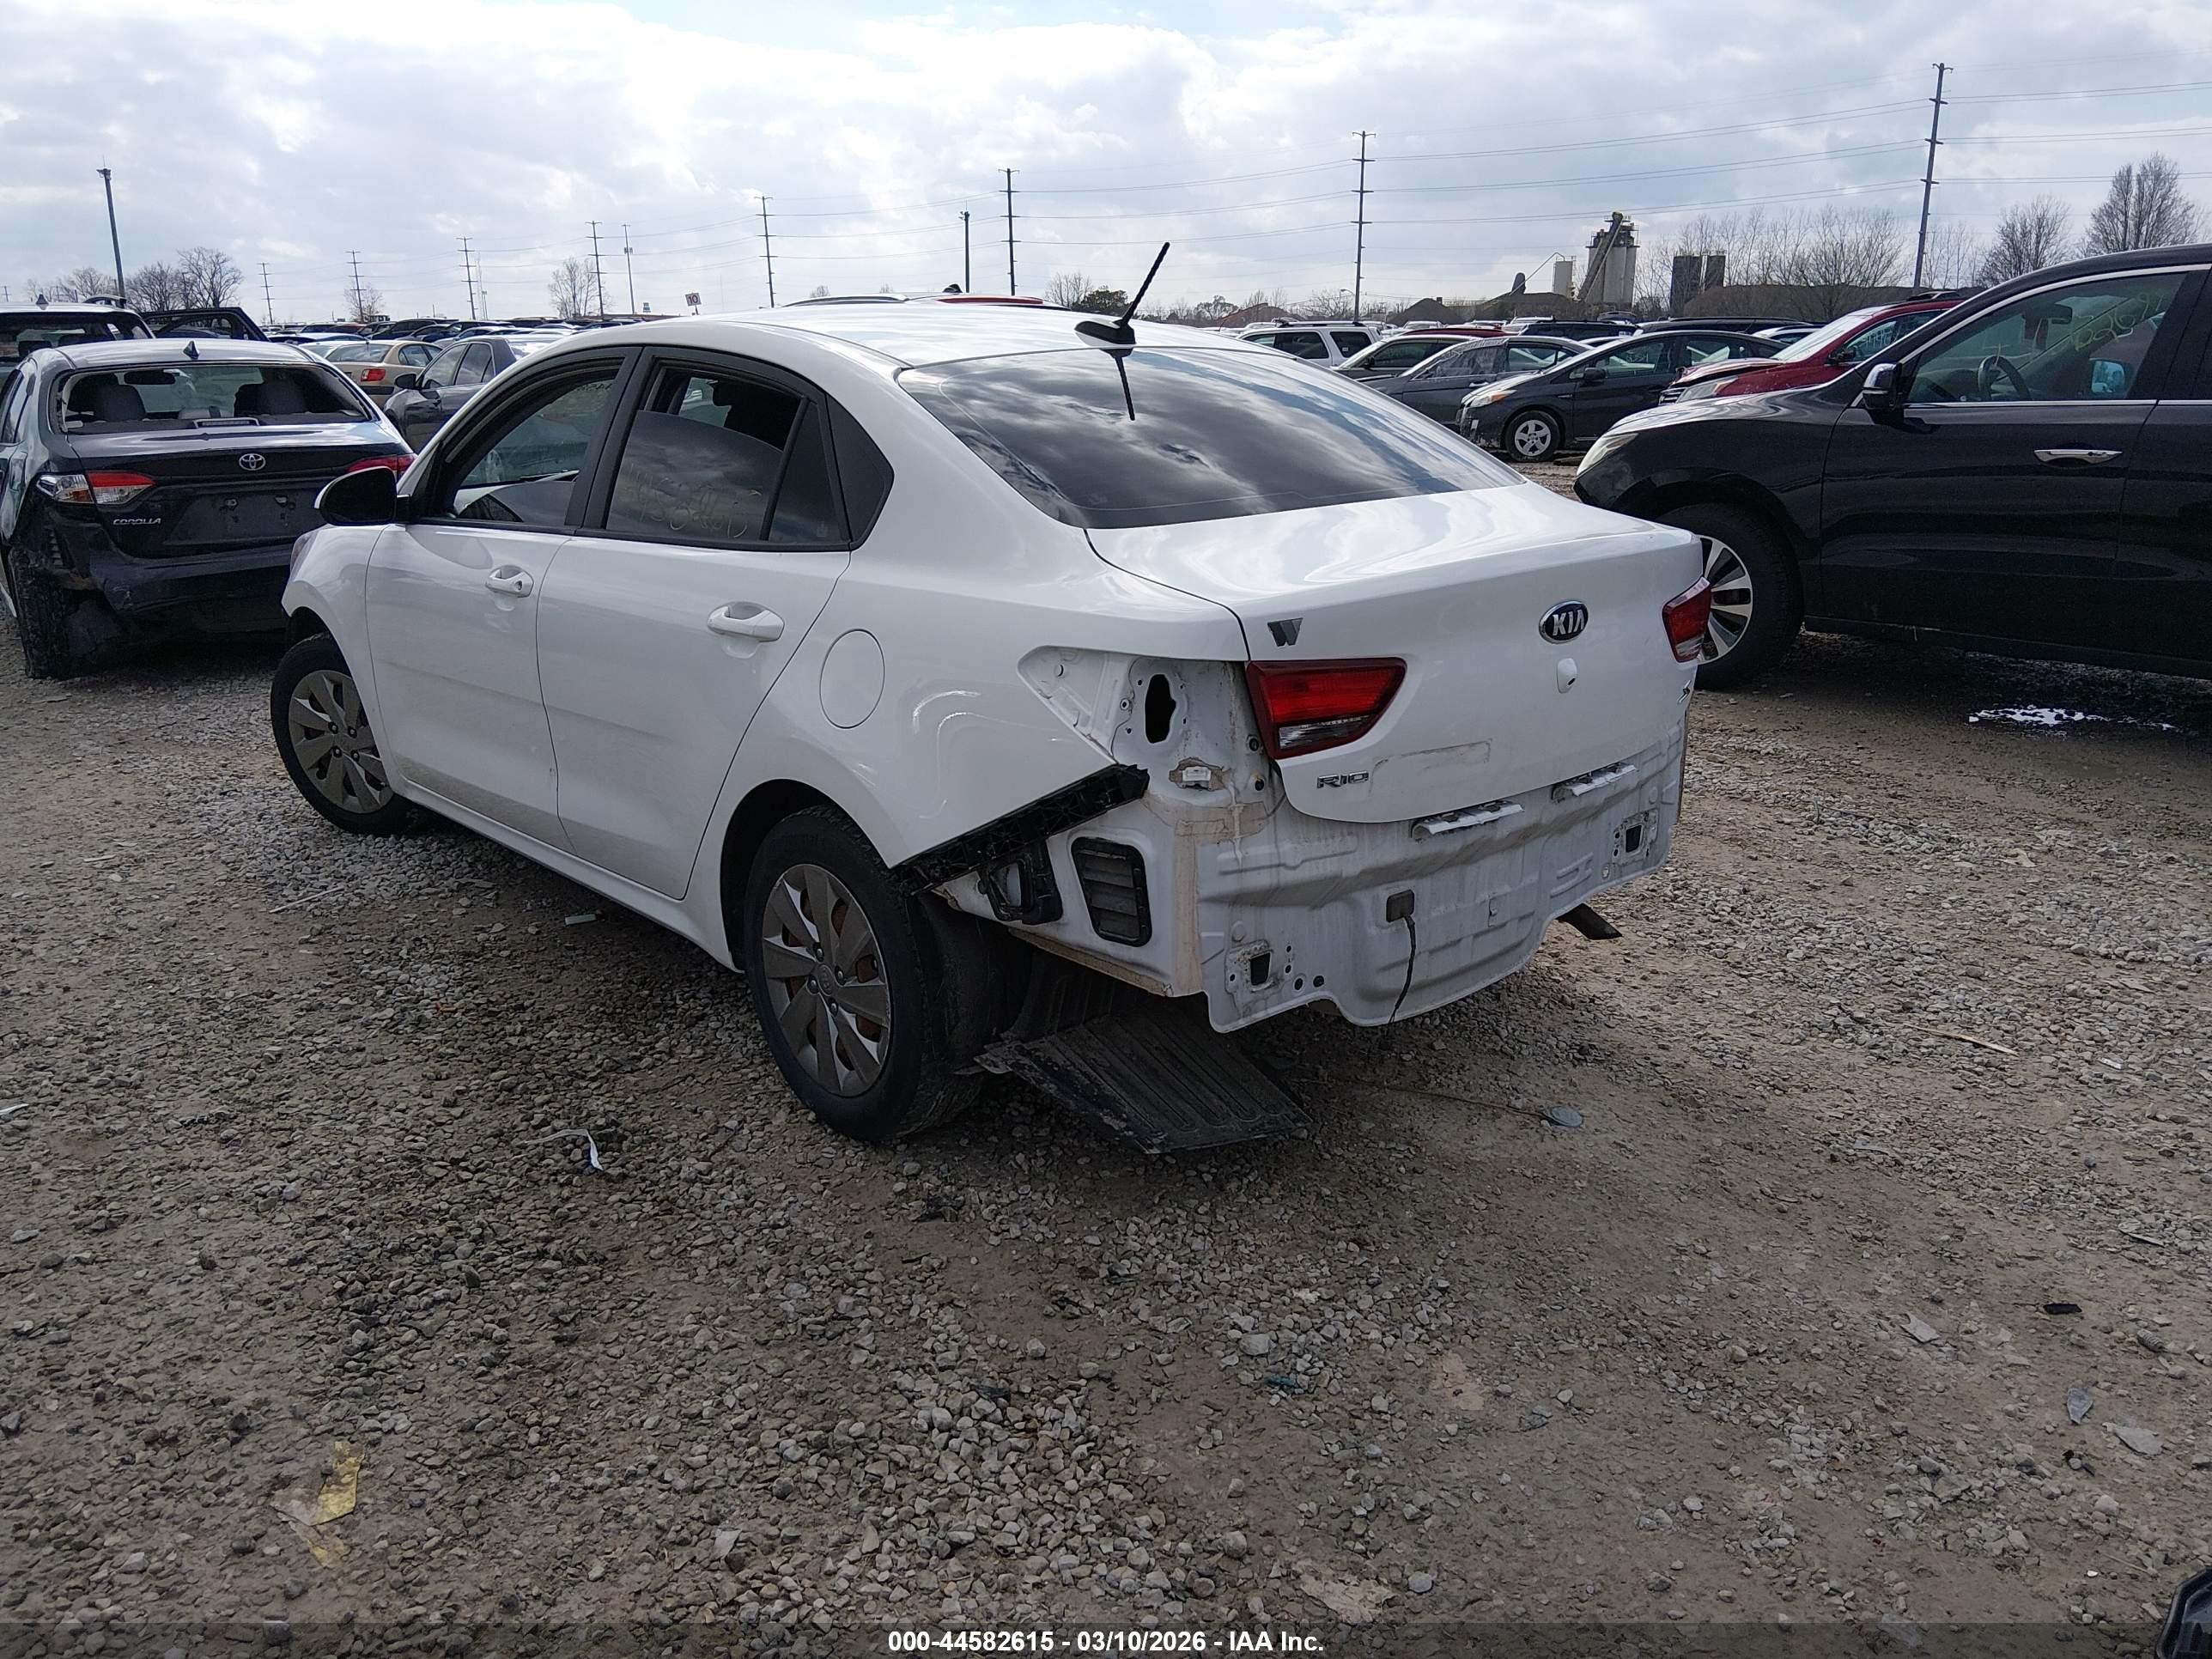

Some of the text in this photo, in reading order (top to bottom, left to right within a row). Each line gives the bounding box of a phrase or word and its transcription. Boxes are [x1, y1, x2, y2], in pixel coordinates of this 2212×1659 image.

[688, 295, 699, 304] 10
[112, 517, 161, 526] COROLLA
[1552, 609, 1585, 636] KIA
[1316, 770, 1370, 788] RIO
